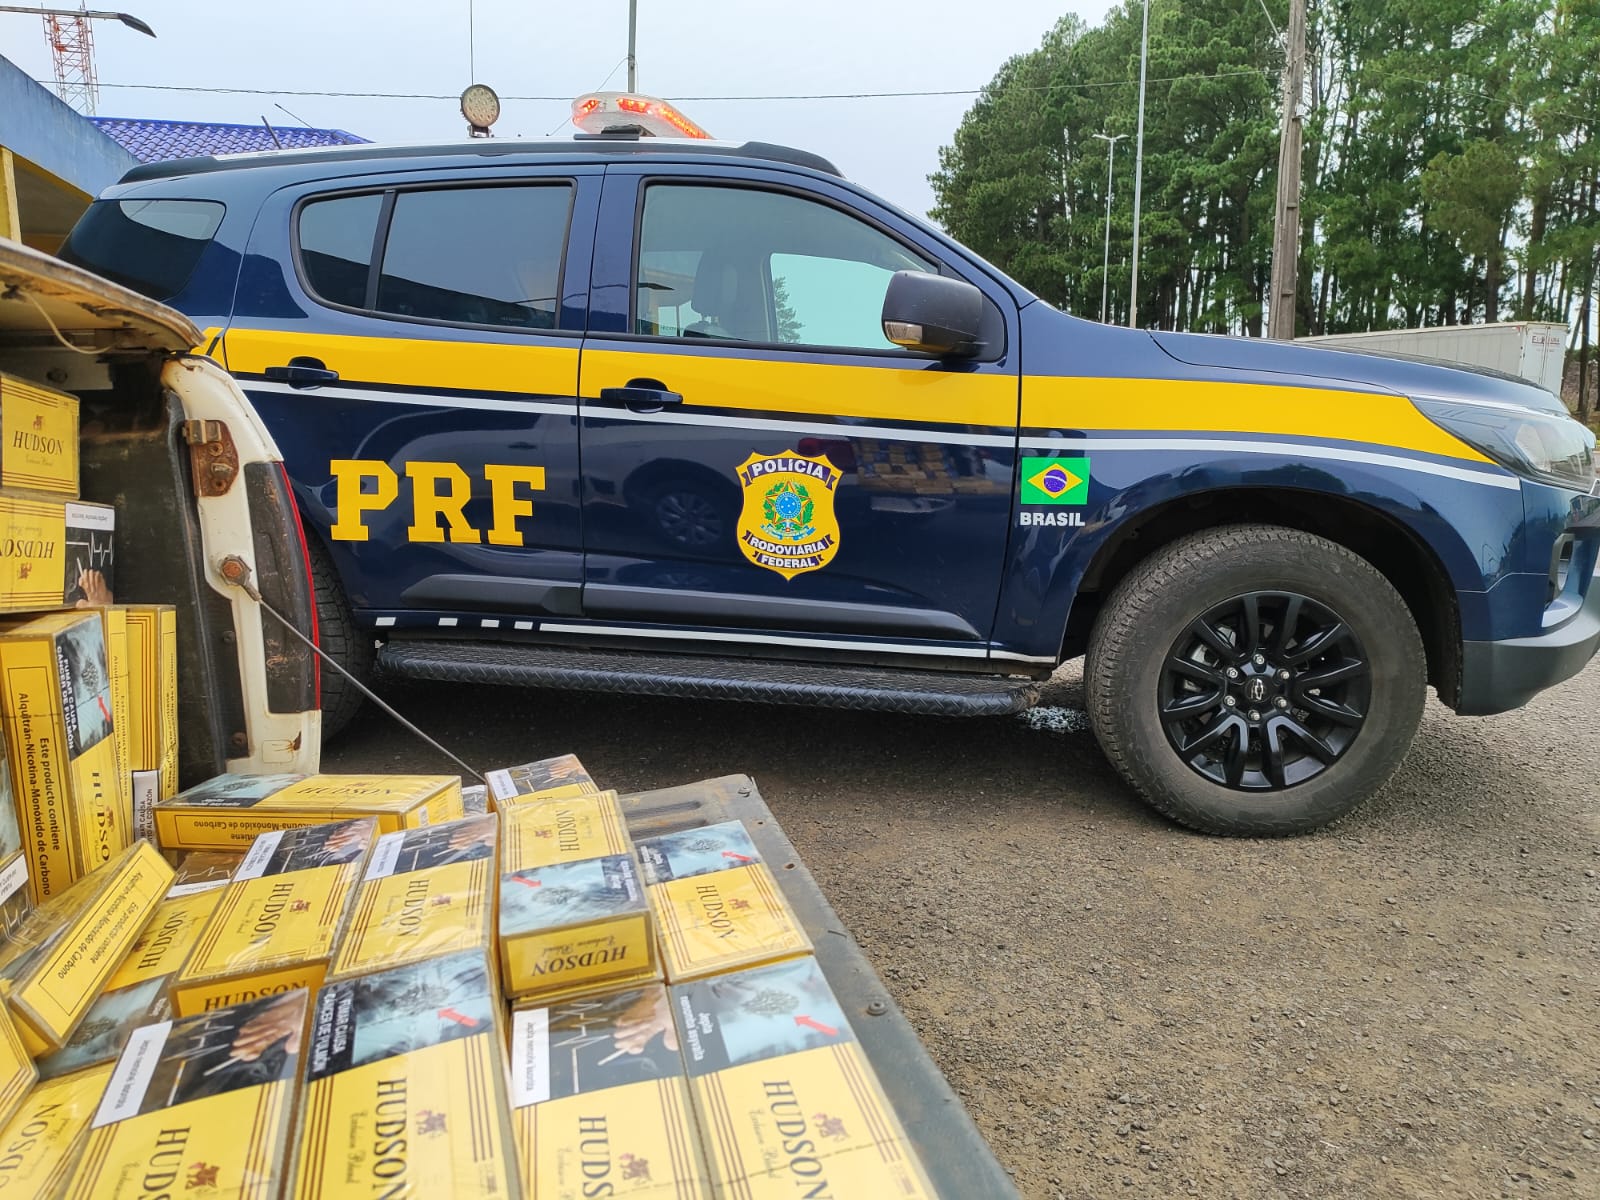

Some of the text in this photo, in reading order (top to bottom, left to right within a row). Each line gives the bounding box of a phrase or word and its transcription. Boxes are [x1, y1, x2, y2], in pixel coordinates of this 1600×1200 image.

[13, 430, 65, 456] HUDSON
[330, 459, 546, 547] PRF
[1020, 512, 1086, 527] BRASIL
[760, 554, 816, 569] FEDERAL
[61, 690, 69, 706] DE
[63, 658, 77, 732] FUMAR CAUSA
[39, 738, 62, 851] Este producto contiene
[194, 820, 227, 830] Carbono
[228, 820, 237, 829] de
[560, 808, 581, 852] HUDSON
[37, 839, 47, 853] de
[39, 853, 51, 896] Carbono
[248, 882, 295, 945] HUDSON
[398, 877, 430, 937] HUDSON
[695, 884, 738, 940] HUDSON
[137, 910, 188, 970] HUDSON
[57, 949, 84, 980] Carbono
[531, 944, 627, 977] HUDSON
